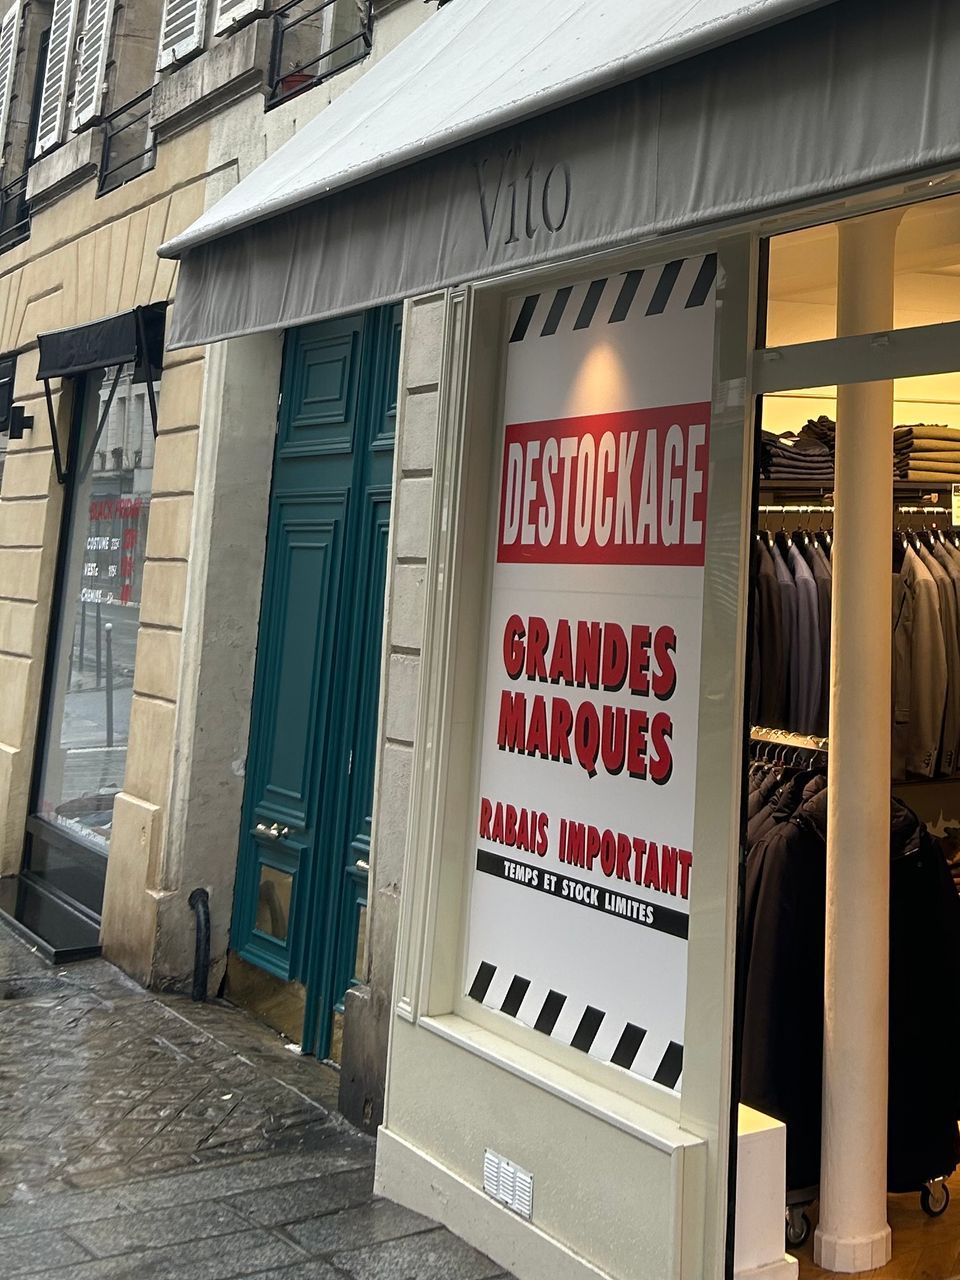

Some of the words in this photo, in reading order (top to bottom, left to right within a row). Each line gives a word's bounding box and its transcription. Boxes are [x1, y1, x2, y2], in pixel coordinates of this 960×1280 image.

[474, 146, 572, 250] Vito
[502, 423, 706, 548] DESTOCKAGE
[86, 536, 110, 550] COSTUME
[502, 613, 678, 702] GRANDES
[497, 689, 674, 786] MARQUES
[479, 796, 549, 858] RABAIS
[558, 818, 693, 901] IMPORTANT
[503, 859, 539, 887] TEMPS
[543, 873, 558, 892] ET
[561, 879, 599, 906] STOCK
[604, 894, 655, 924] LIMITES
